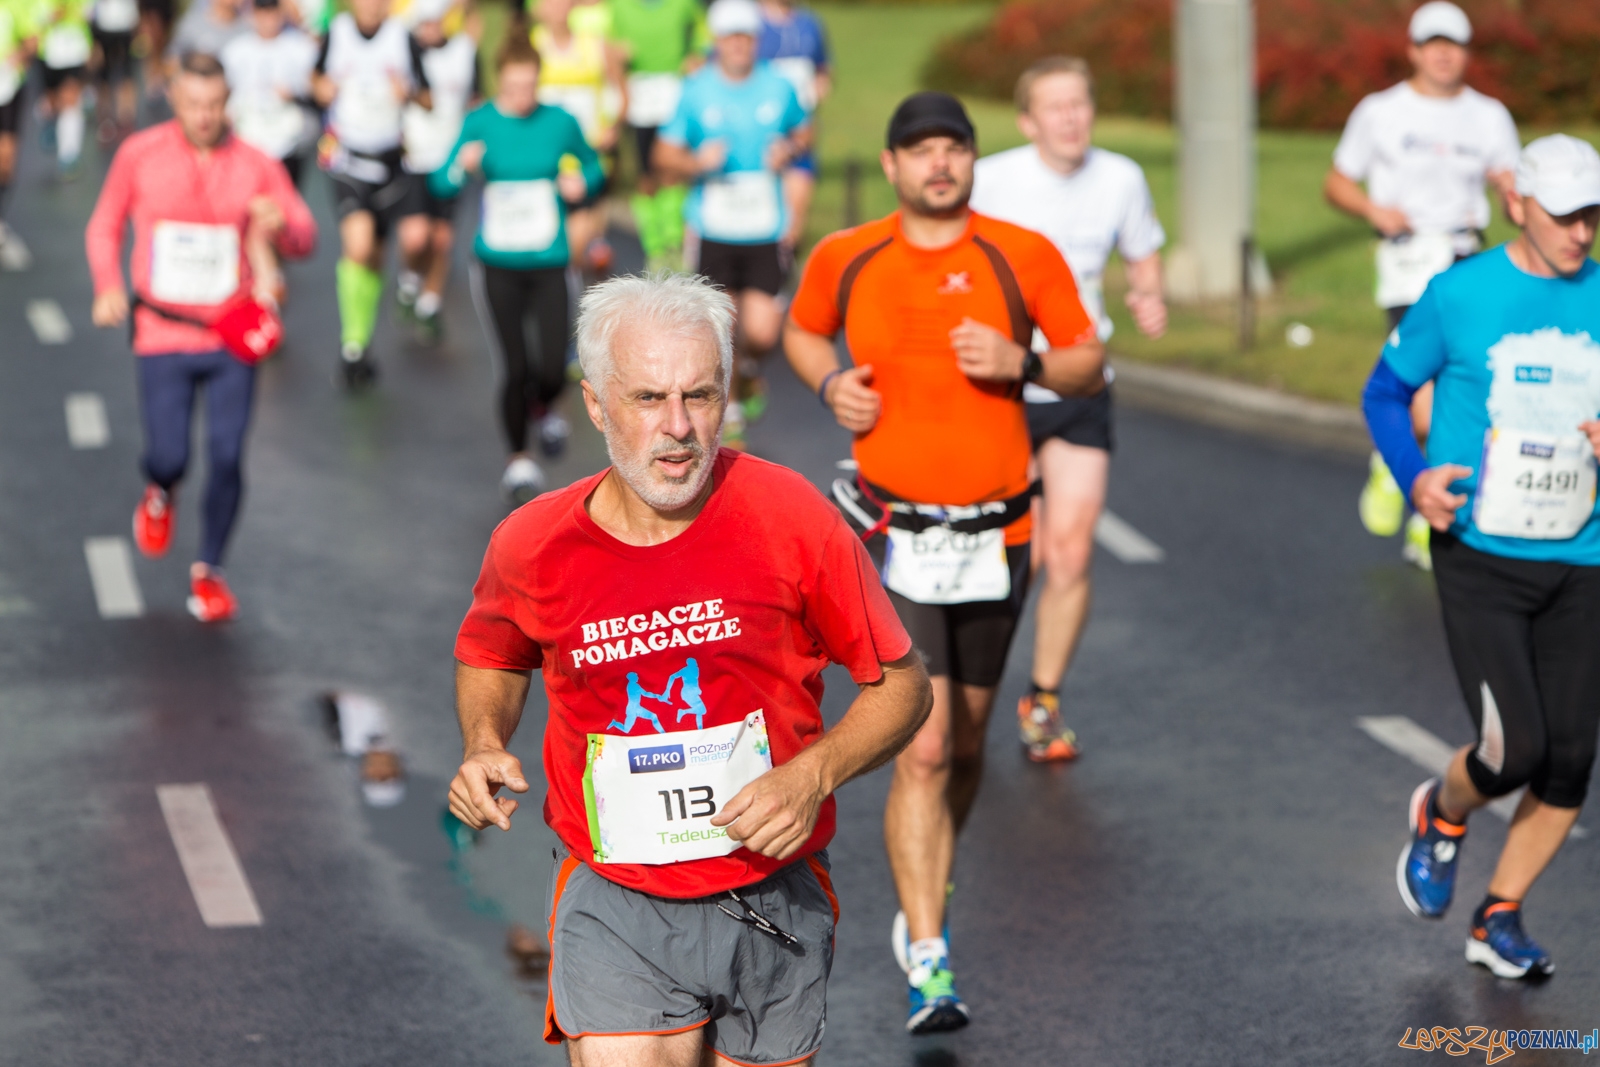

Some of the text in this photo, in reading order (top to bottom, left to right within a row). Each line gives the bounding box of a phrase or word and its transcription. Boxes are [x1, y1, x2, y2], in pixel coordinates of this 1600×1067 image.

[1516, 469, 1579, 494] 4491
[581, 598, 724, 643] BIEGACZE
[569, 617, 741, 668] POMAGACZE
[658, 785, 717, 821] 113
